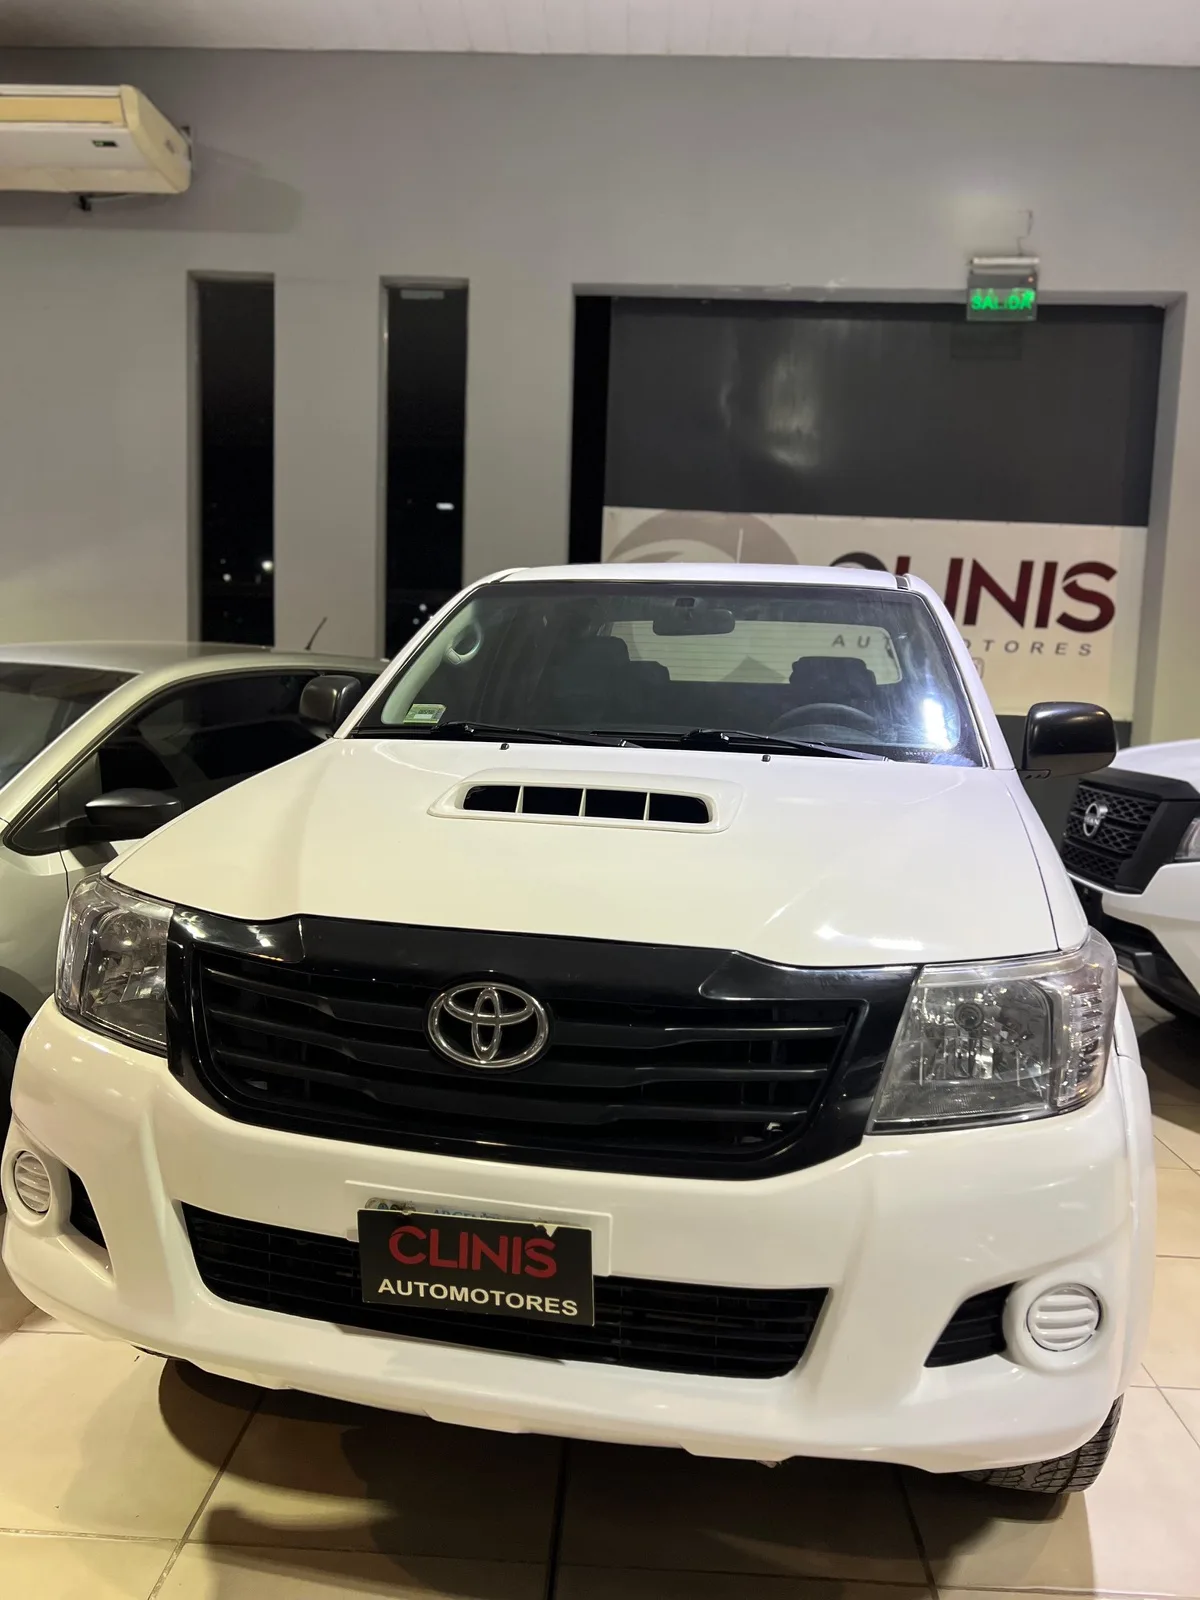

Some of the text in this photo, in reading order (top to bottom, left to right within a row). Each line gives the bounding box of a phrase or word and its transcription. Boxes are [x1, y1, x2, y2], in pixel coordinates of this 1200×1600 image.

[829, 551, 1118, 633] INIS
[388, 1225, 557, 1278] CLINIS
[377, 1278, 578, 1317] AUTOMOTORES
